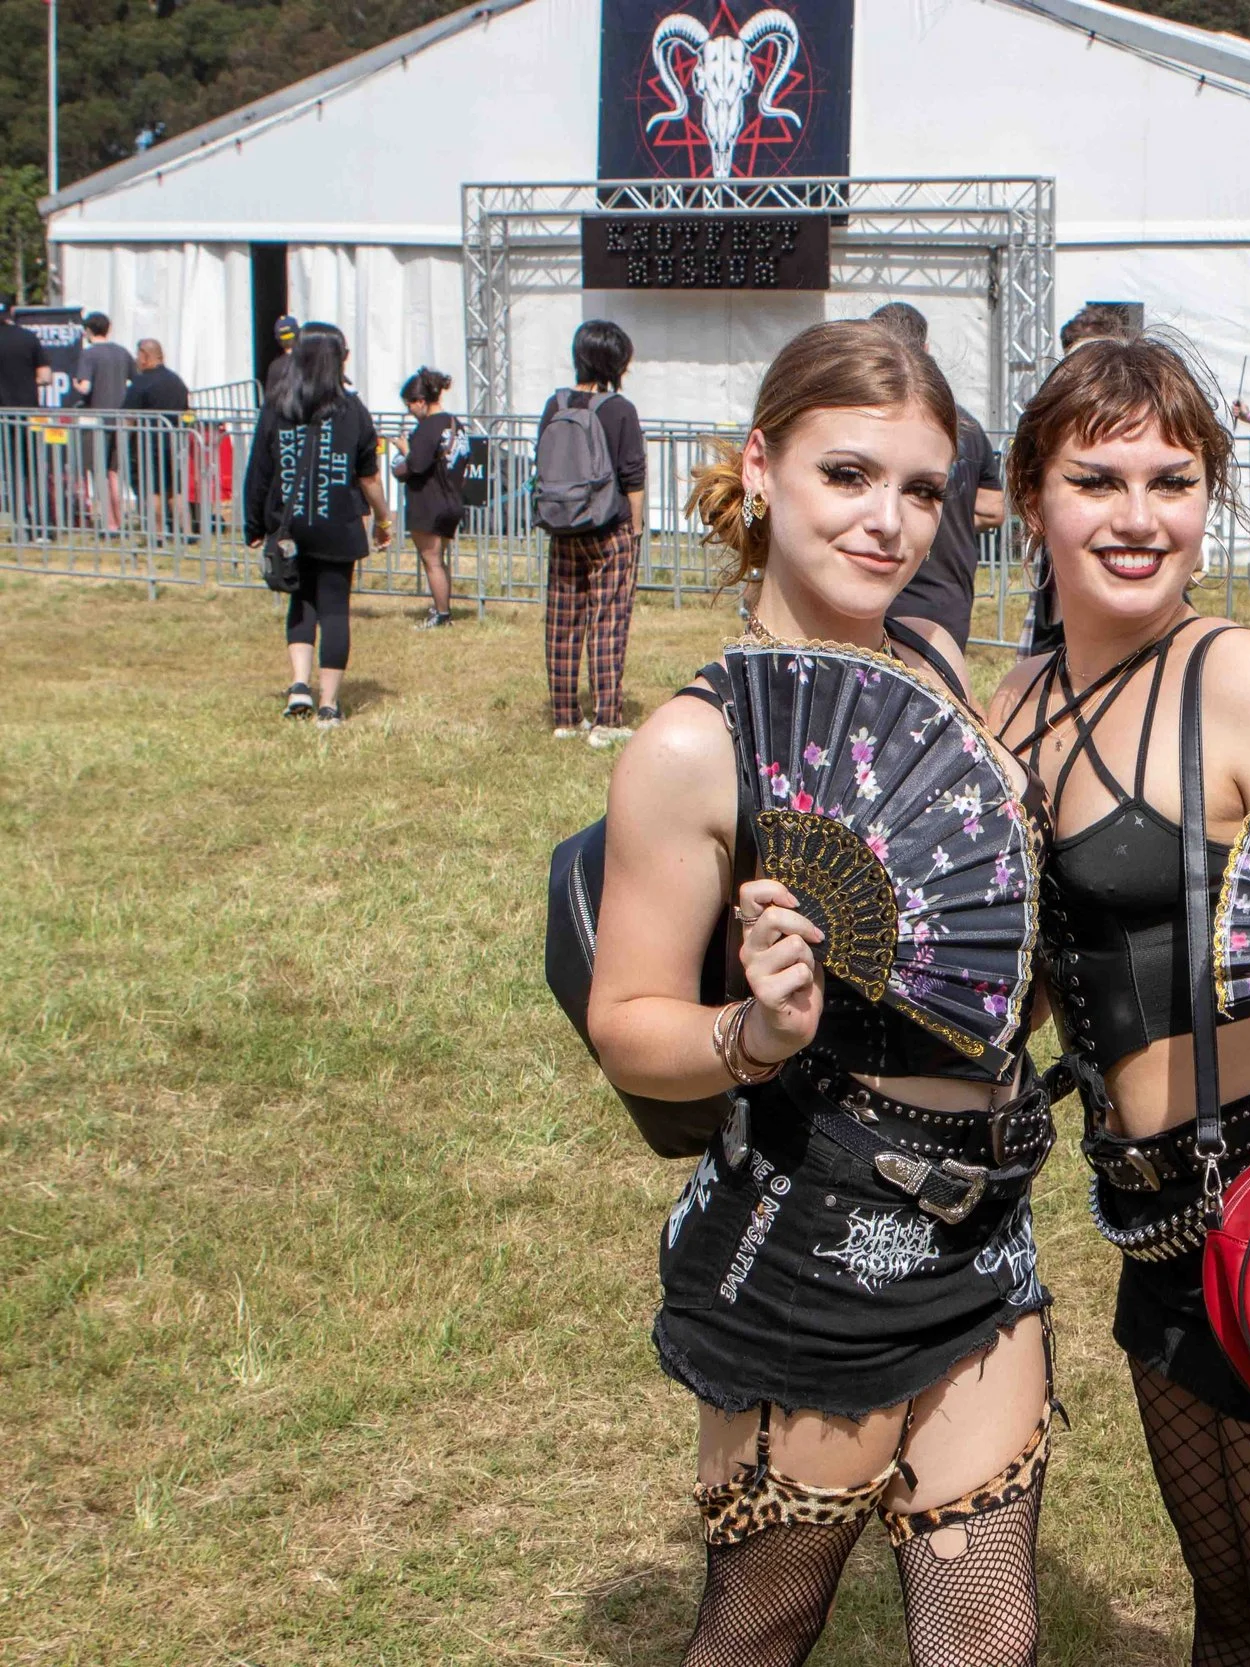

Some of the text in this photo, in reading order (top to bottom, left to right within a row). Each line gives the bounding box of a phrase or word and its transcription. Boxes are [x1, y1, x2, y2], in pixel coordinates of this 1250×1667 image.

[606, 221, 799, 250] KNOTFEST
[331, 452, 348, 486] LIE
[770, 1175, 791, 1195] O
